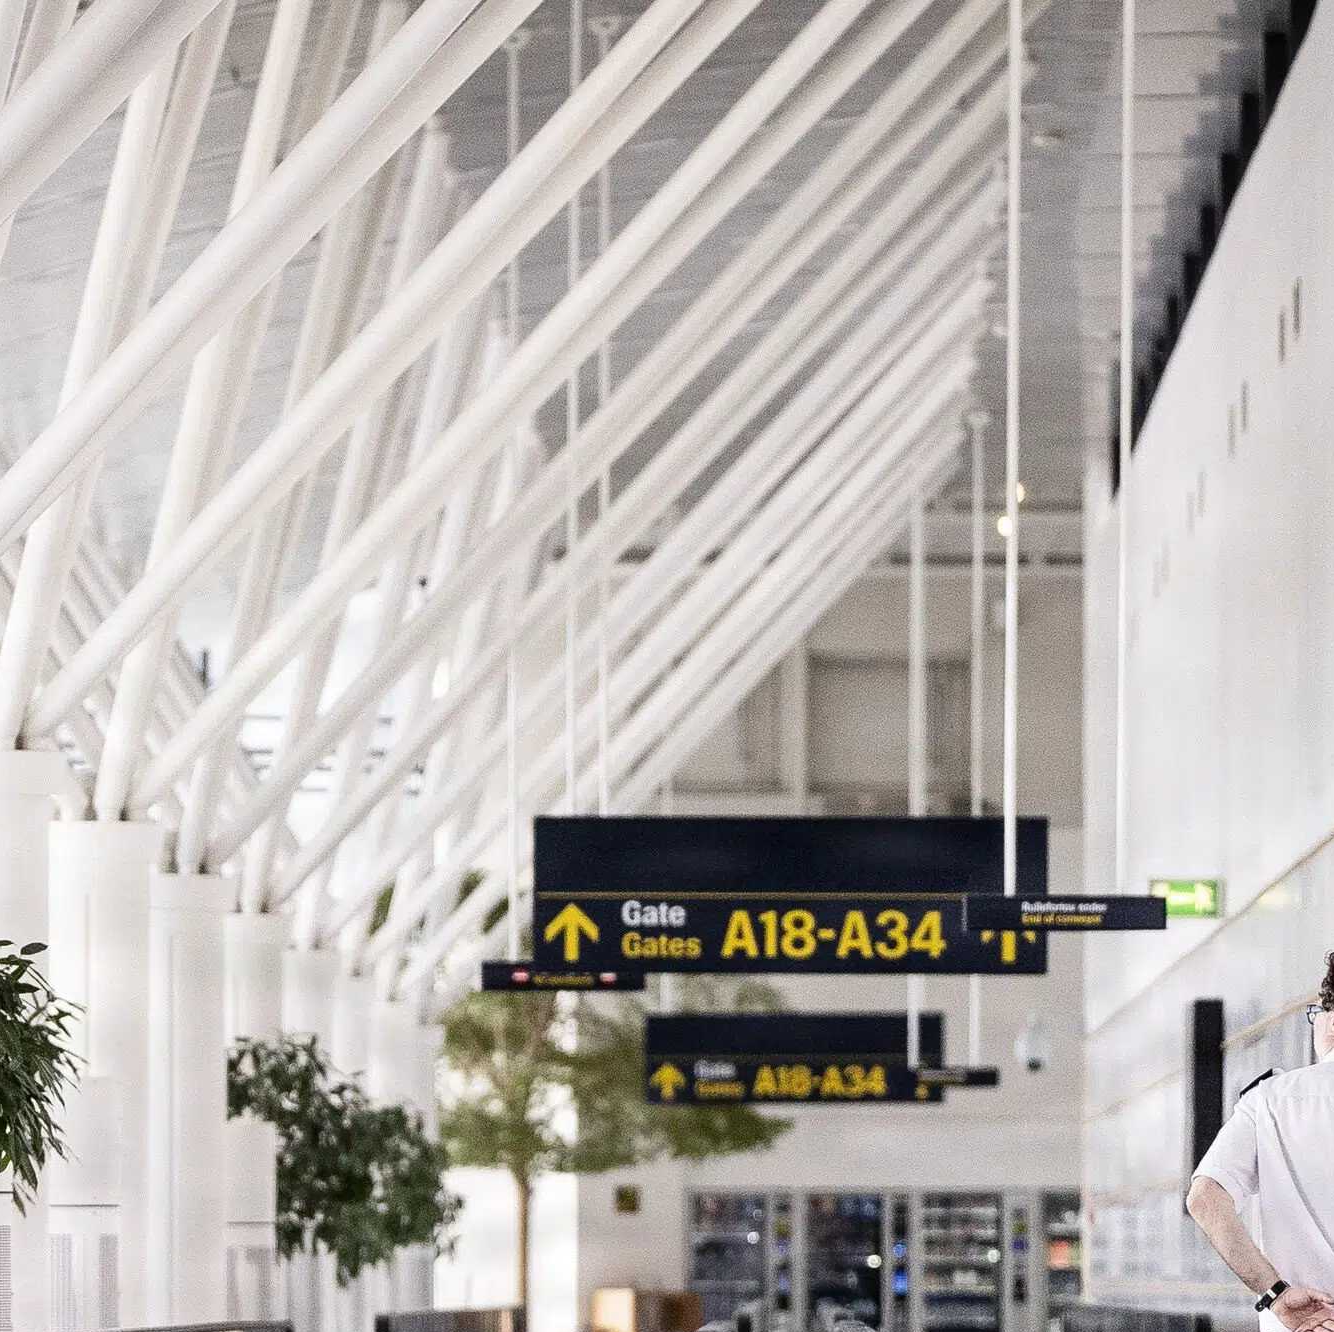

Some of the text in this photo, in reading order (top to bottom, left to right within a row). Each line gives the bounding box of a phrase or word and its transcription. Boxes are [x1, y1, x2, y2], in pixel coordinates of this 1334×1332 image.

[621, 900, 687, 927] Gate
[621, 932, 702, 959] Gates
[720, 909, 947, 960] A18-A34
[752, 1064, 888, 1098] A18-A34
